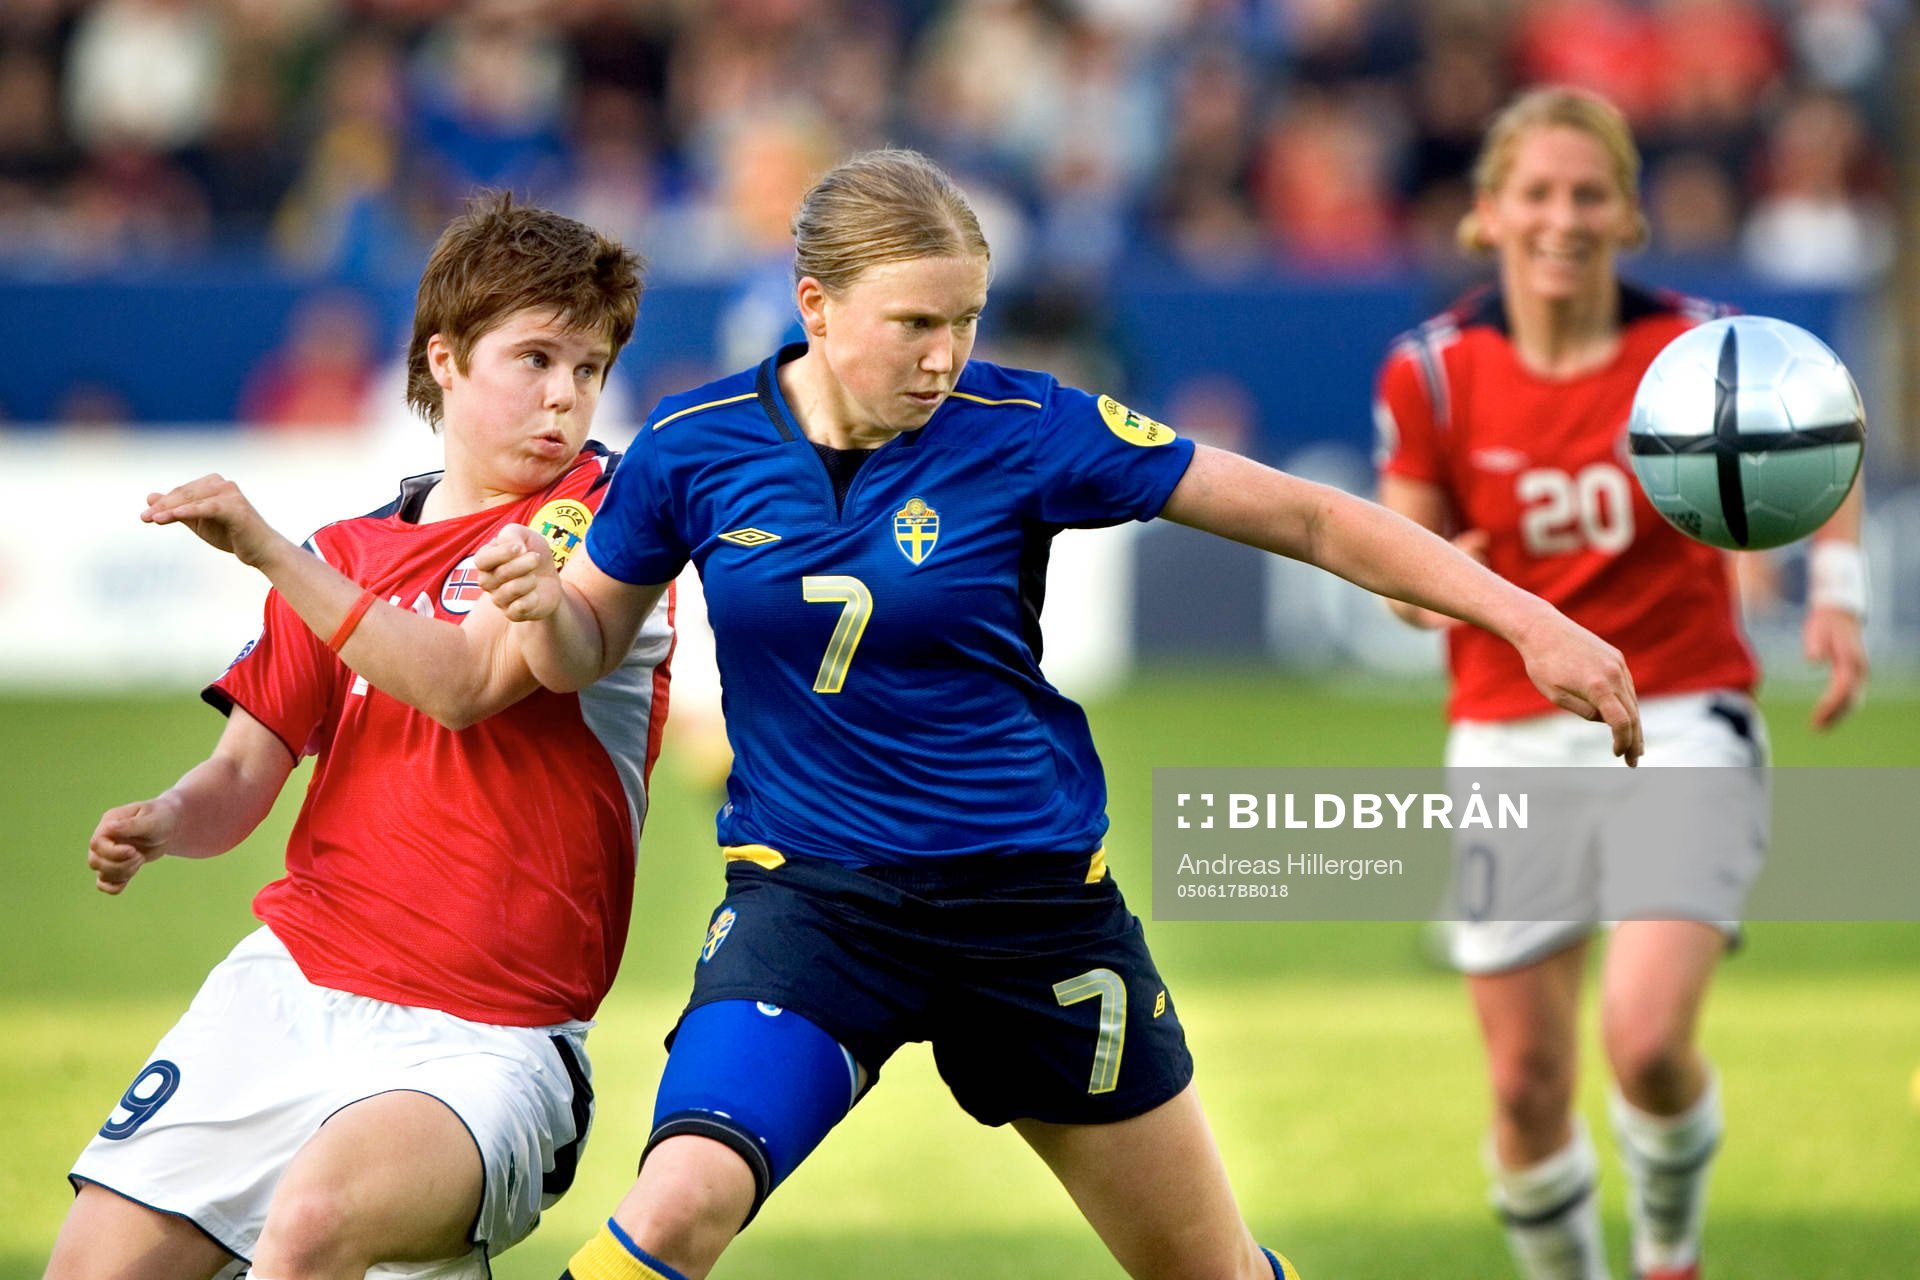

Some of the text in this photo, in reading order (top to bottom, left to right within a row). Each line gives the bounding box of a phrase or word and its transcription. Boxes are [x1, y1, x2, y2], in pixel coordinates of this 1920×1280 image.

[556, 508, 583, 526] UEFA
[1517, 465, 1634, 555] 20
[802, 575, 873, 693] 7
[1052, 968, 1127, 1094] 7
[98, 1059, 180, 1140] 9
